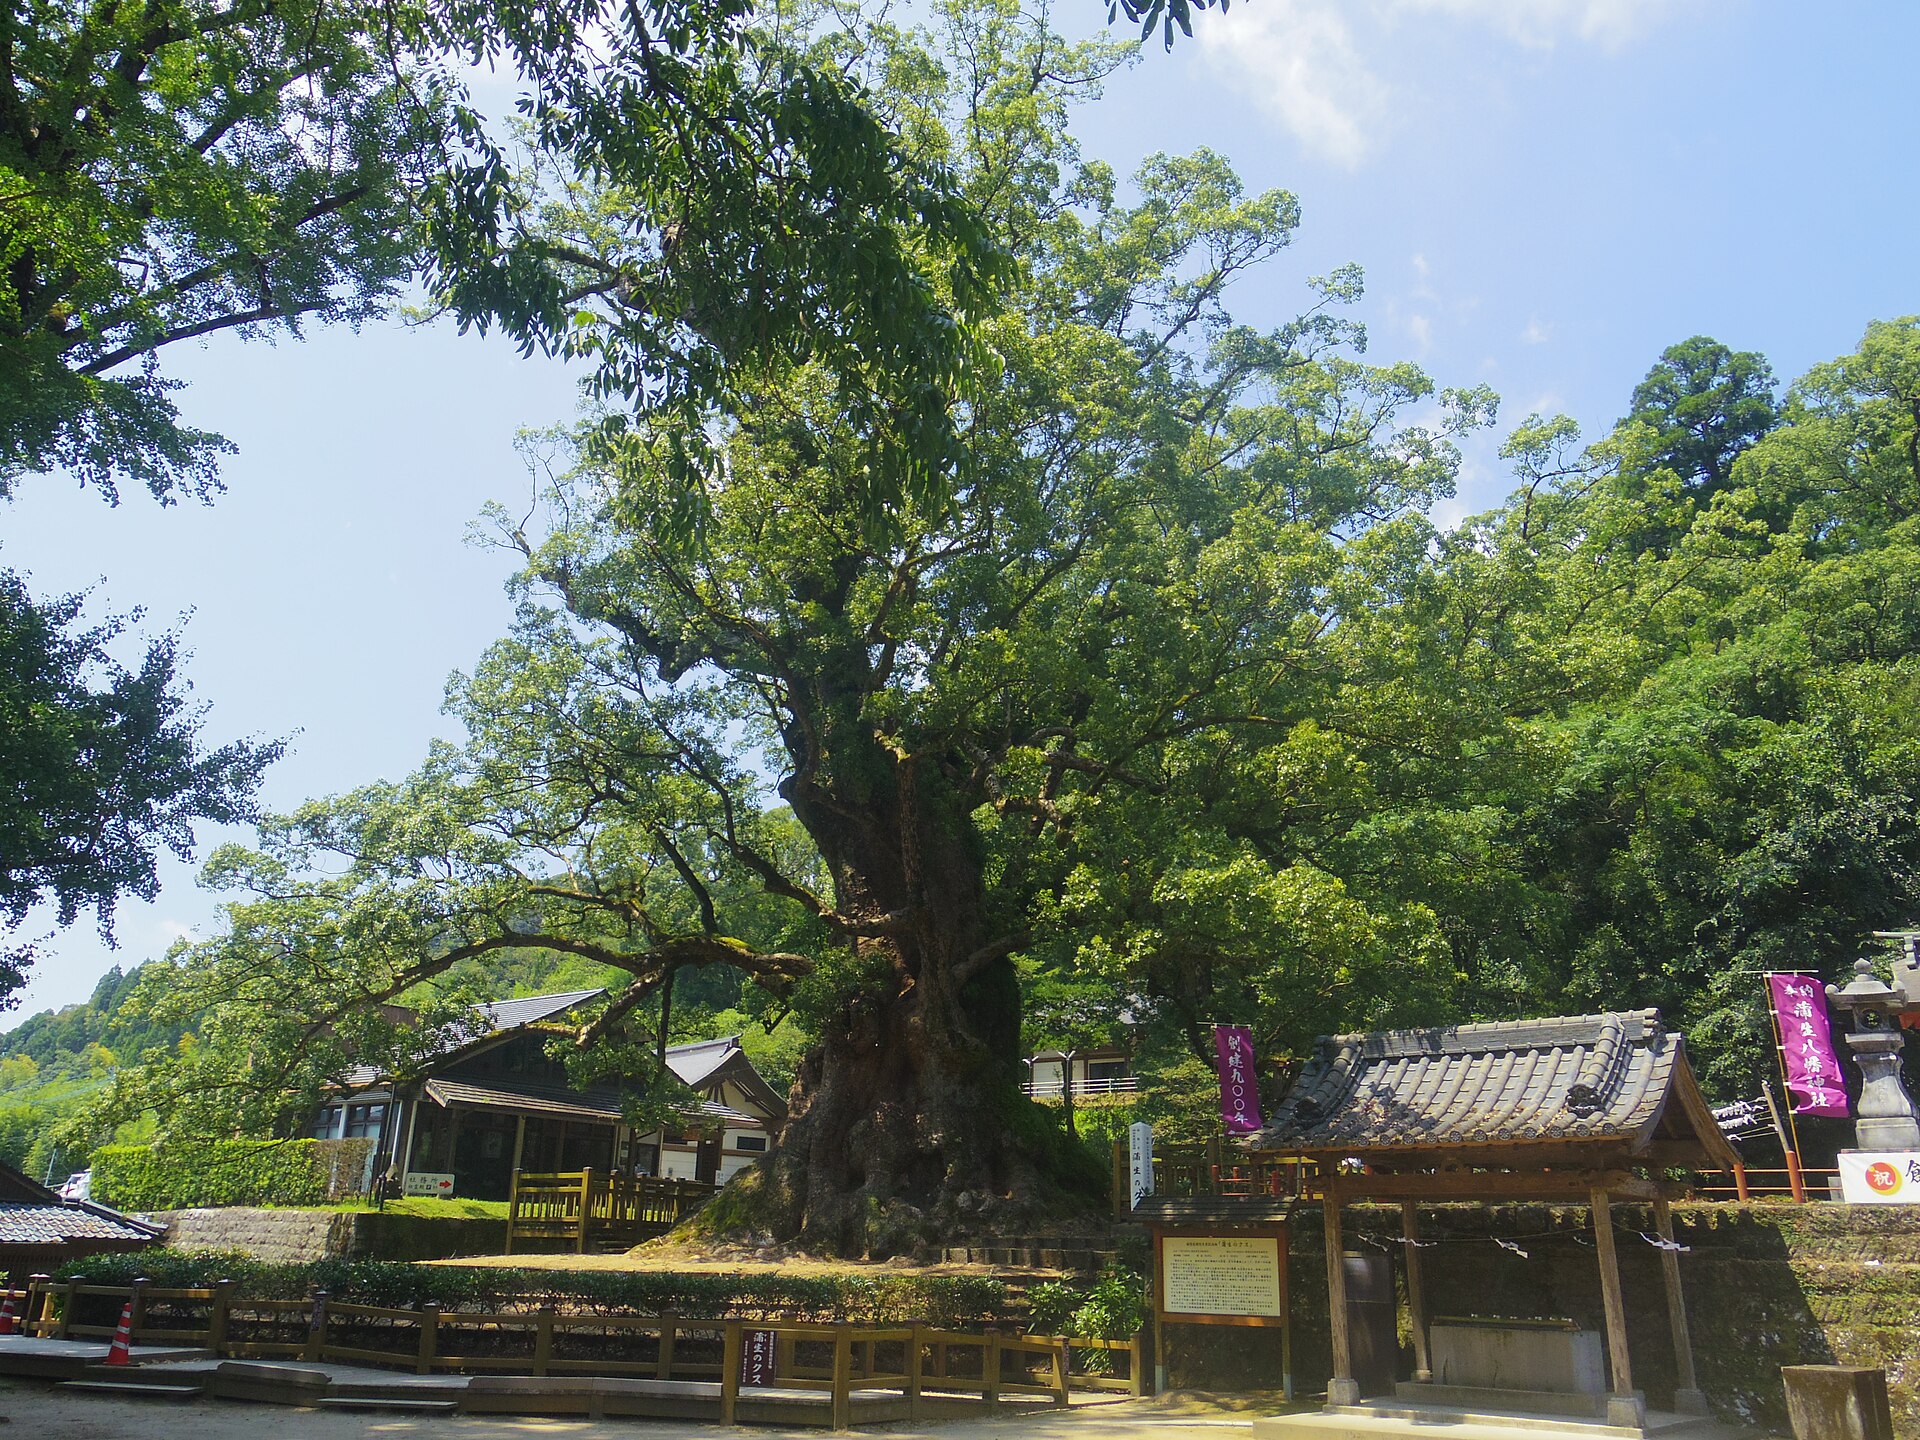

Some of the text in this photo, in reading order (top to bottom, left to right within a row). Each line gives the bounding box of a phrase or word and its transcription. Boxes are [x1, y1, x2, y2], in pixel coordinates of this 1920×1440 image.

[1793, 1000, 1831, 1108] 蒲生八幡神社
[1872, 1170, 1894, 1187] 祝
[752, 1332, 763, 1384] 蒲生のクス
